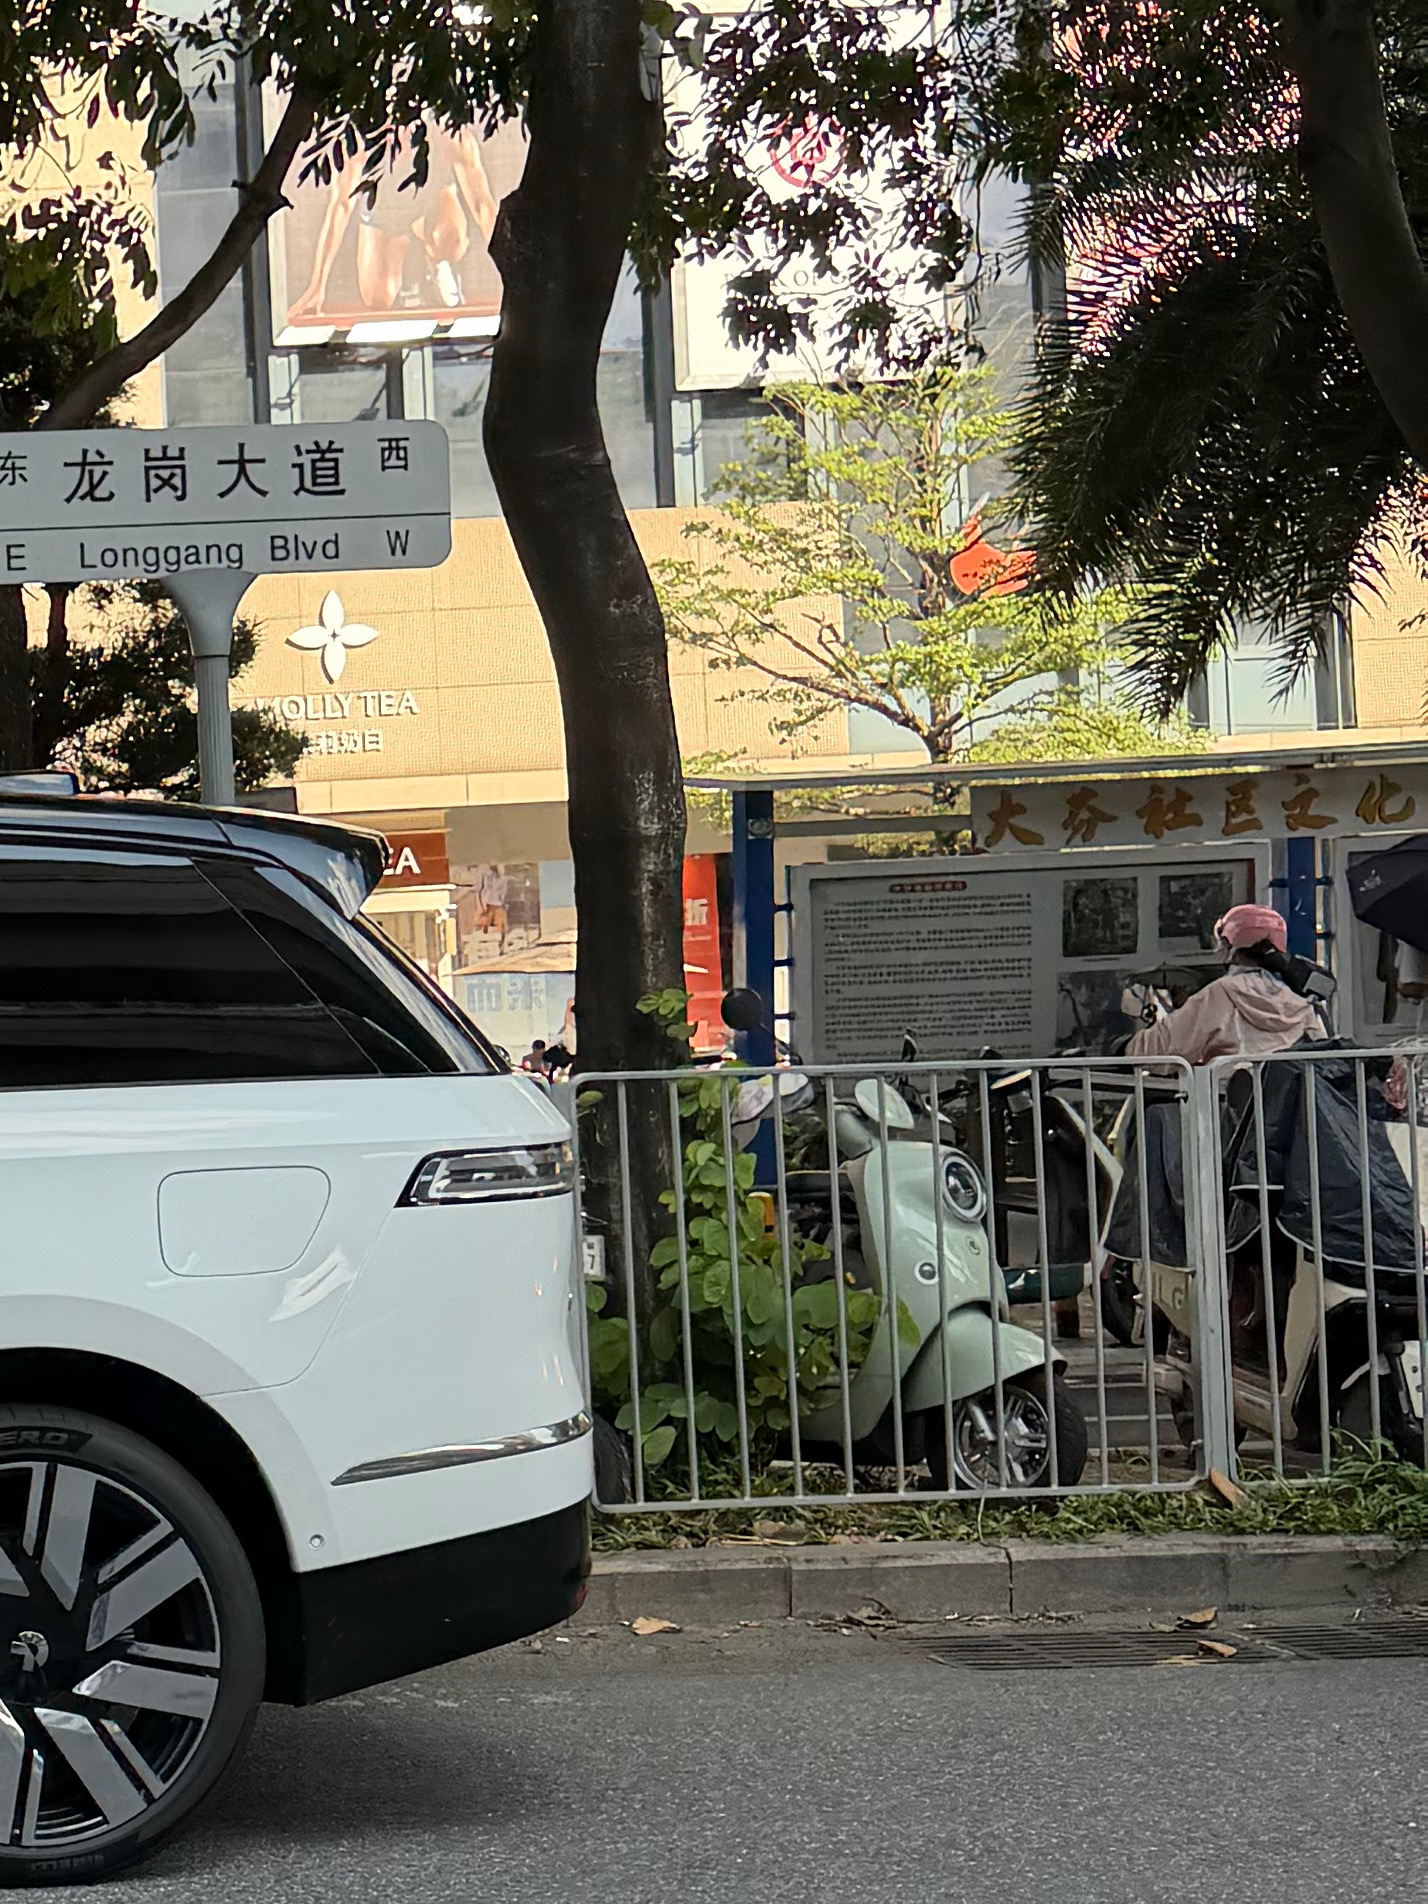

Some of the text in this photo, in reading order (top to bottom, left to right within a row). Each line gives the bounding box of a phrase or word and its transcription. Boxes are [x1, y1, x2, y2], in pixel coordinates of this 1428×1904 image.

[63, 440, 347, 504] 龙岗大道
[376, 437, 412, 472] 西
[6, 530, 410, 574] E Longgang Blvd W
[359, 689, 421, 717] TEA
[984, 773, 1416, 848] 大芬社区文化
